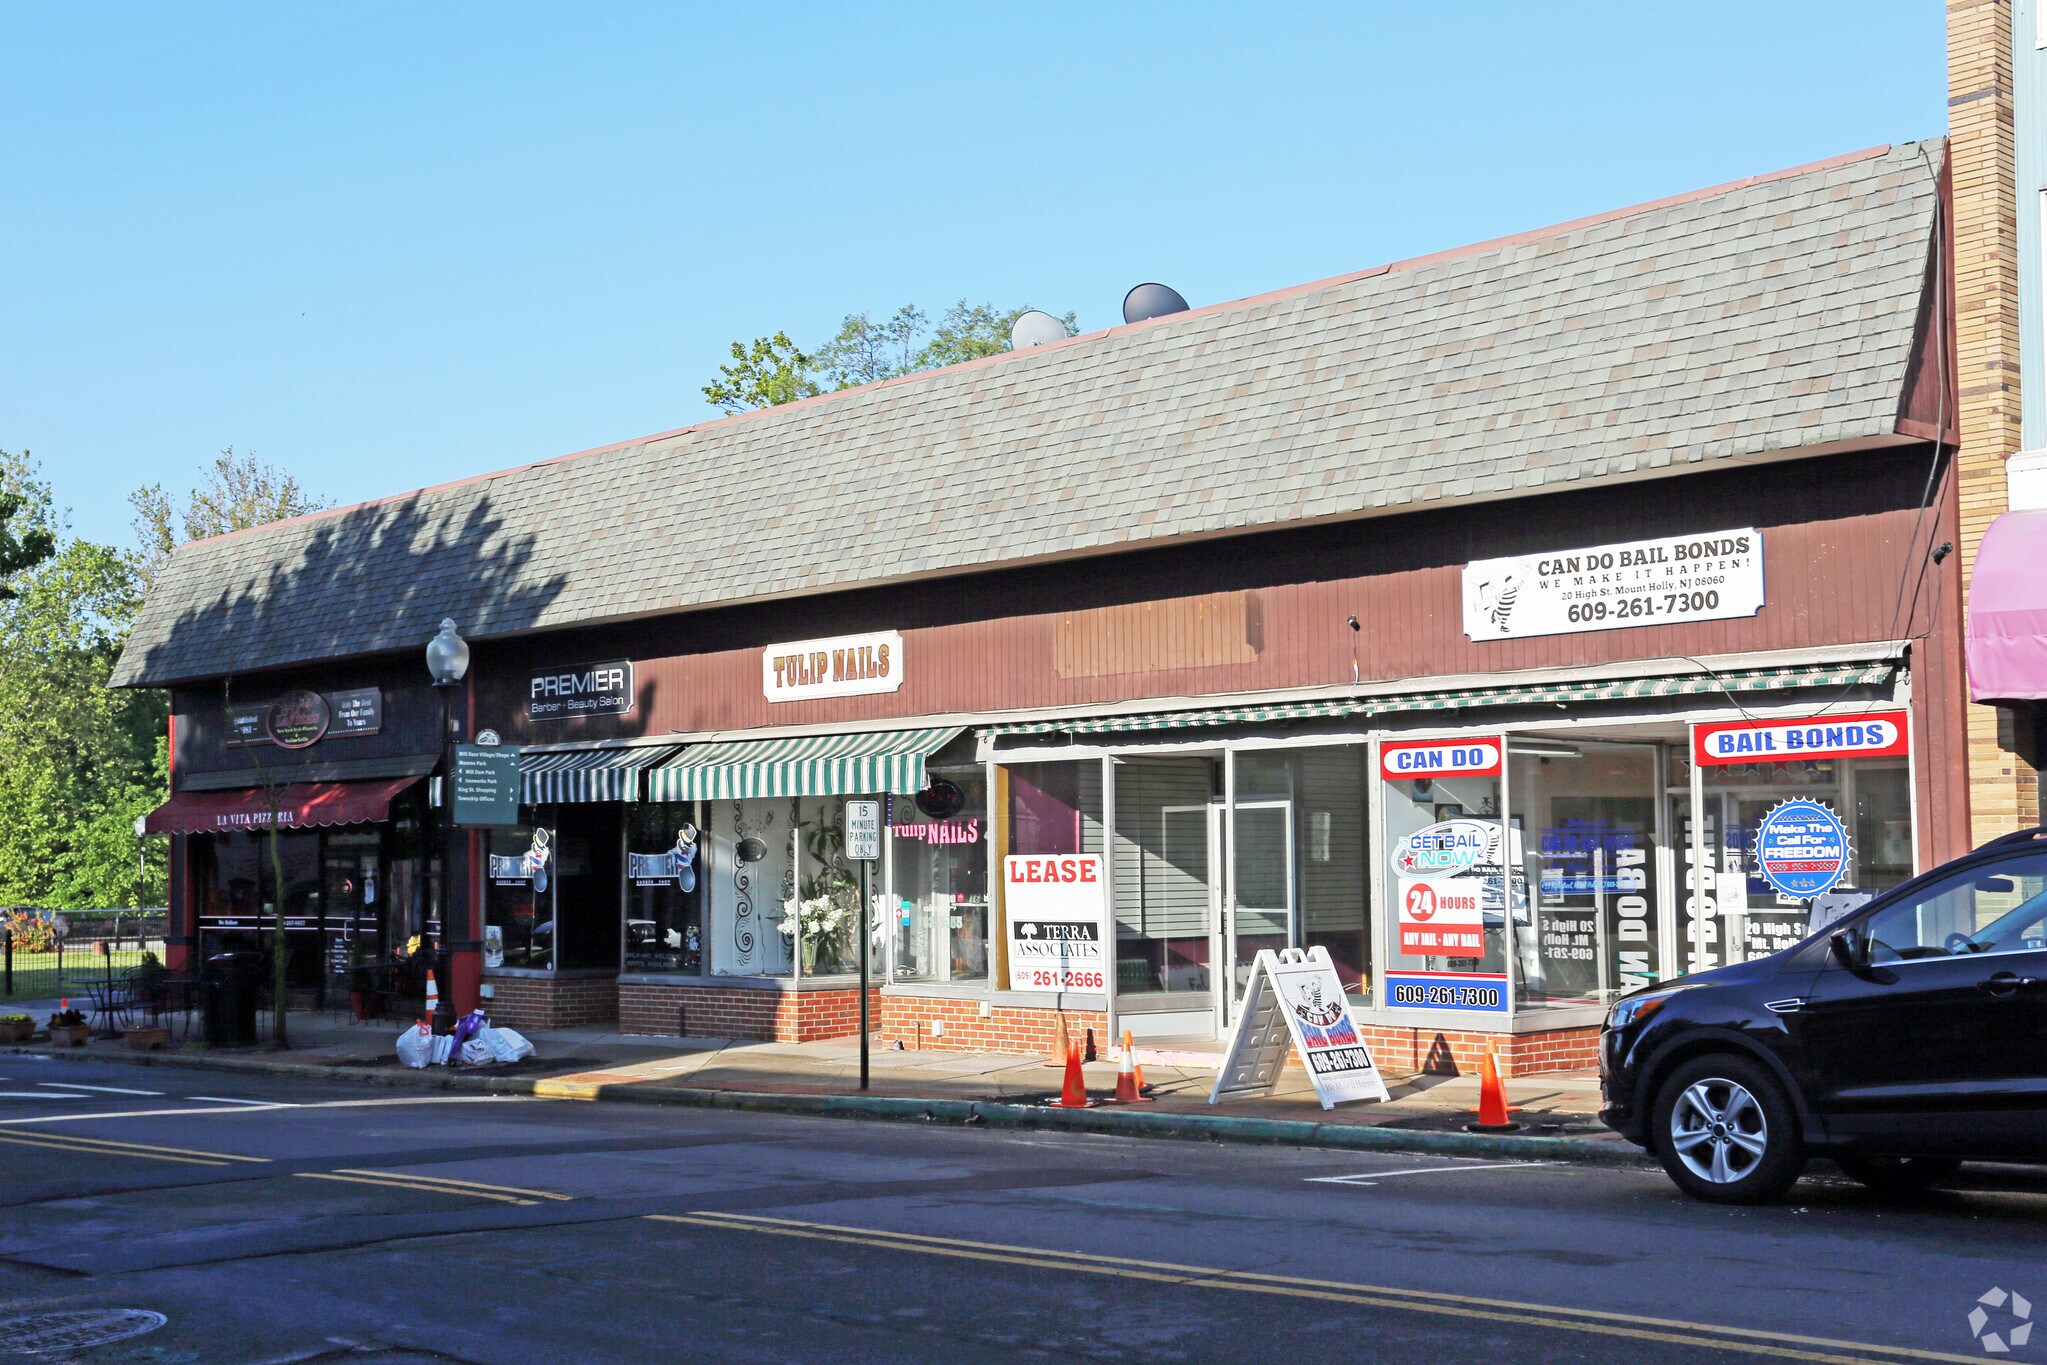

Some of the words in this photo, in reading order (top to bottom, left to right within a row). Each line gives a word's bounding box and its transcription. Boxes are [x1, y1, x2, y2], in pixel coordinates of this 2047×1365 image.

[1538, 556, 1581, 576] CAN
[1586, 552, 1614, 571] DO
[1619, 546, 1668, 568] BAIL
[1674, 536, 1750, 561] BONDS
[1540, 579, 1561, 590] WE
[1573, 572, 1623, 586] MAKE
[1635, 569, 1652, 579] IT
[1561, 591, 1573, 601] 20
[1574, 588, 1598, 601] High
[1600, 587, 1613, 597] St.
[1615, 584, 1646, 596] Mount
[1648, 580, 1678, 593] Holly,
[1679, 578, 1693, 590] NJ
[1694, 575, 1725, 586] 08060
[1568, 589, 1720, 623] 609-261-7300
[773, 651, 828, 688] TULIP
[832, 643, 890, 682] NAILS
[531, 668, 624, 699] PREMIER
[532, 702, 561, 714] Barber
[567, 698, 598, 711] Beauty
[599, 696, 624, 707] Salon
[1718, 732, 1776, 754] BAIL
[1786, 724, 1884, 748] BONDS
[1397, 750, 1442, 770] CAN
[1452, 748, 1484, 766] DO
[217, 815, 228, 826] LA
[230, 813, 251, 825] VITA
[253, 811, 294, 824] PIZZRIA
[858, 805, 869, 818] 15
[852, 820, 874, 830] MINUTE
[928, 818, 978, 844] NAILS
[1770, 824, 1806, 835] Make
[1806, 824, 1833, 833] The
[850, 831, 876, 842] PARKING
[1410, 834, 1442, 849] GET
[1446, 834, 1481, 848] BAIL
[1776, 836, 1801, 846] Call
[1802, 834, 1826, 845] For
[855, 844, 871, 856] ONLY
[1420, 850, 1476, 866] NOW
[1764, 846, 1840, 859] FREEDOM
[1010, 860, 1096, 882] LEASE
[1408, 891, 1434, 914] 24
[1440, 896, 1476, 910] HOURS
[1043, 924, 1092, 940] TERRA
[1744, 922, 1761, 935] 20
[1762, 922, 1792, 936] High
[1404, 932, 1421, 946] ANY
[1422, 932, 1438, 946] JAIL
[1442, 932, 1460, 948] ANY
[1460, 932, 1480, 948] BAIL
[1751, 937, 1771, 950] Mt.
[1772, 937, 1803, 950] Holl
[1016, 942, 1098, 958] ASSOCIATES
[1015, 970, 1032, 980] (609)
[1396, 986, 1498, 1006] 609-261-7300
[1306, 1012, 1325, 1025] CAN
[1325, 1010, 1337, 1024] DO
[1297, 1019, 1328, 1048] BAIL
[1326, 1014, 1358, 1046] BONDS
[1310, 1048, 1368, 1072] 609-261-7300
